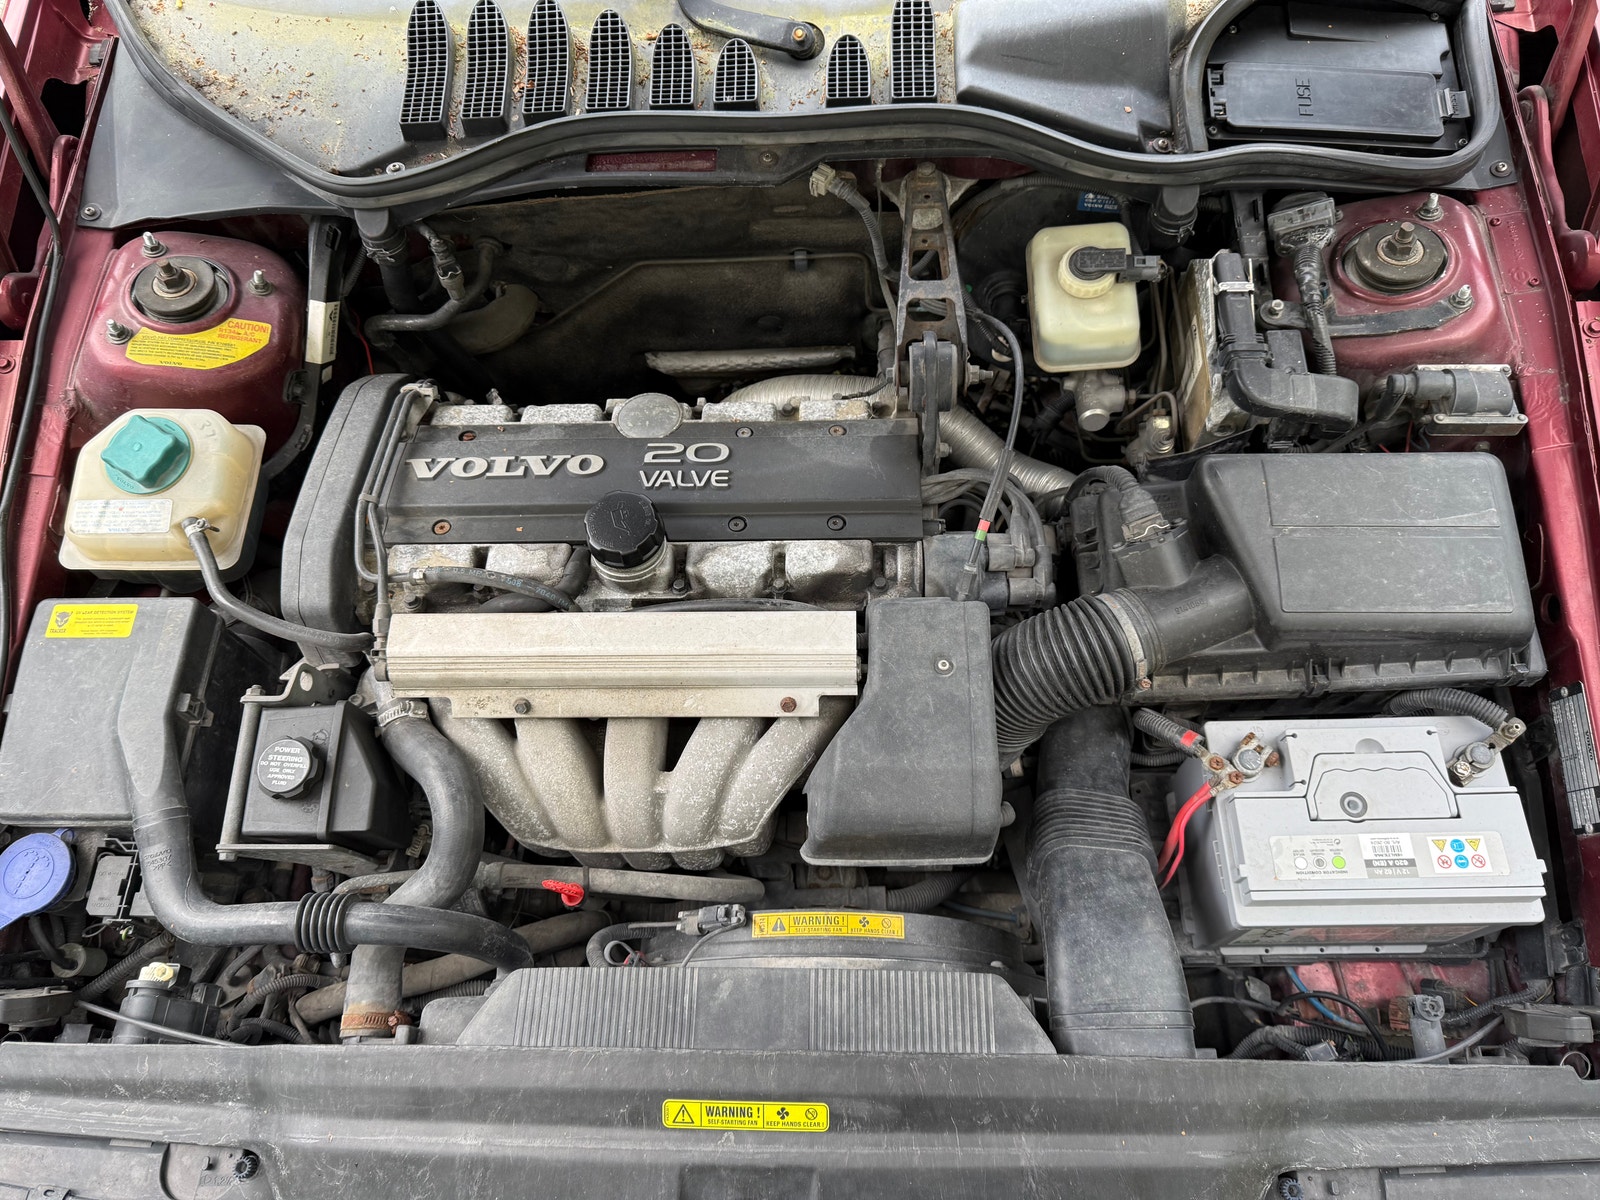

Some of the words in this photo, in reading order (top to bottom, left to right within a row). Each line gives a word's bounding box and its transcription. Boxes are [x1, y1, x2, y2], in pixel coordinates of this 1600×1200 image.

[1295, 78, 1313, 117] FUSE
[227, 320, 269, 333] CAUTION!
[217, 333, 262, 344] REFRIGERANT
[644, 443, 729, 463] 20
[406, 454, 604, 479] VOLVO
[639, 469, 729, 487] VALVE
